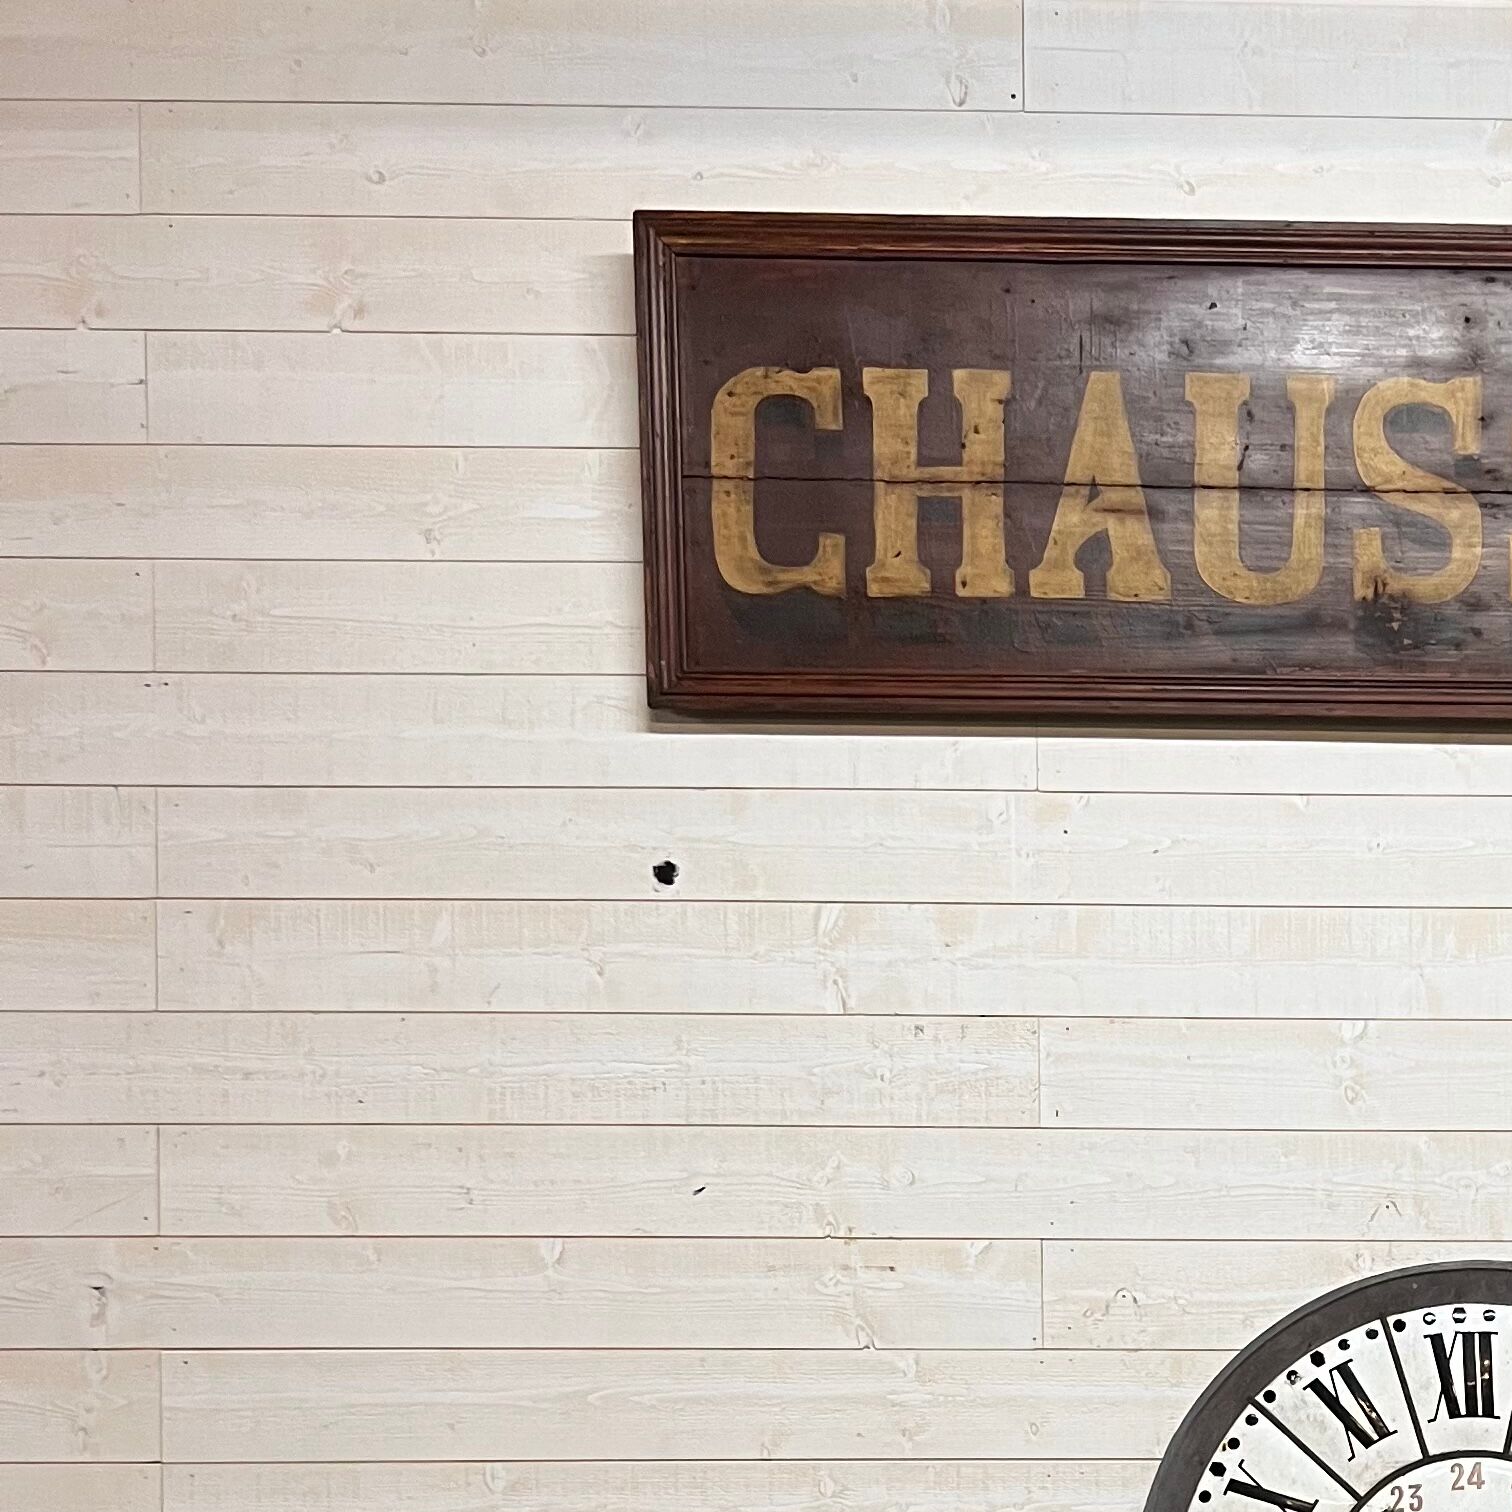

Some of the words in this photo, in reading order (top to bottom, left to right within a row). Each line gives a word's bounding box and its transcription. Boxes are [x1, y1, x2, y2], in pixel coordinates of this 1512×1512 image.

[1424, 1331, 1501, 1423] XII
[1303, 1358, 1398, 1462] XI
[1390, 1484, 1424, 1512] 23
[1451, 1462, 1486, 1491] 24
